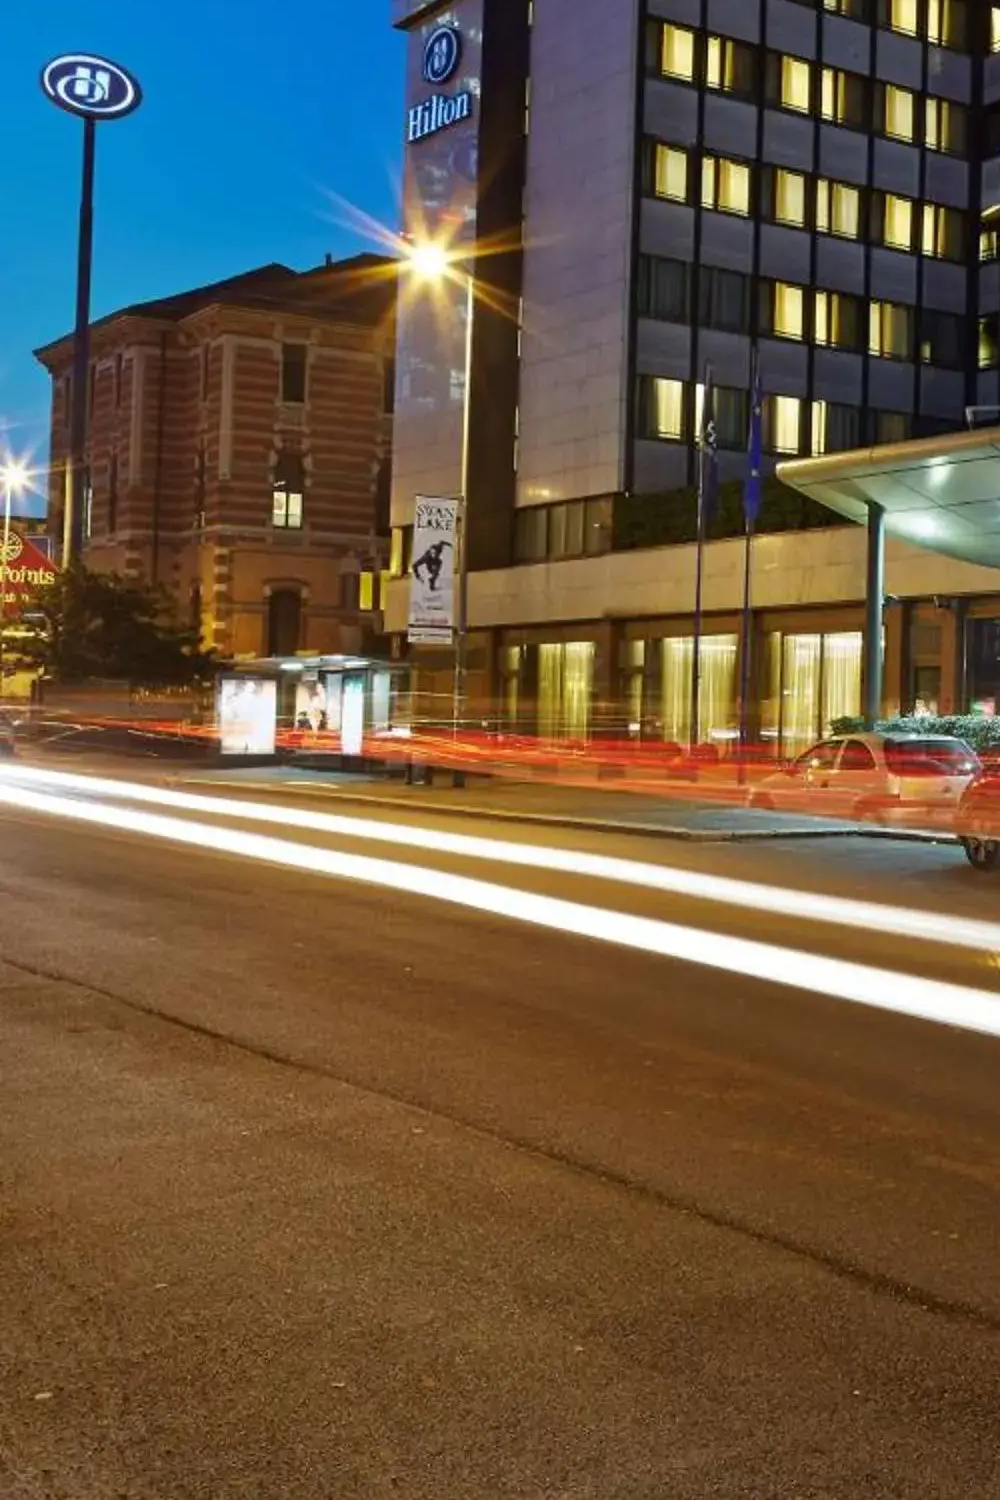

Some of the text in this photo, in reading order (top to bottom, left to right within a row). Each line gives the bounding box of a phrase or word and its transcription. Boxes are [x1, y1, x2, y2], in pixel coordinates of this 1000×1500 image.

[408, 93, 469, 141] Hilton
[417, 518, 453, 531] LAKE
[0, 566, 55, 585] Points
